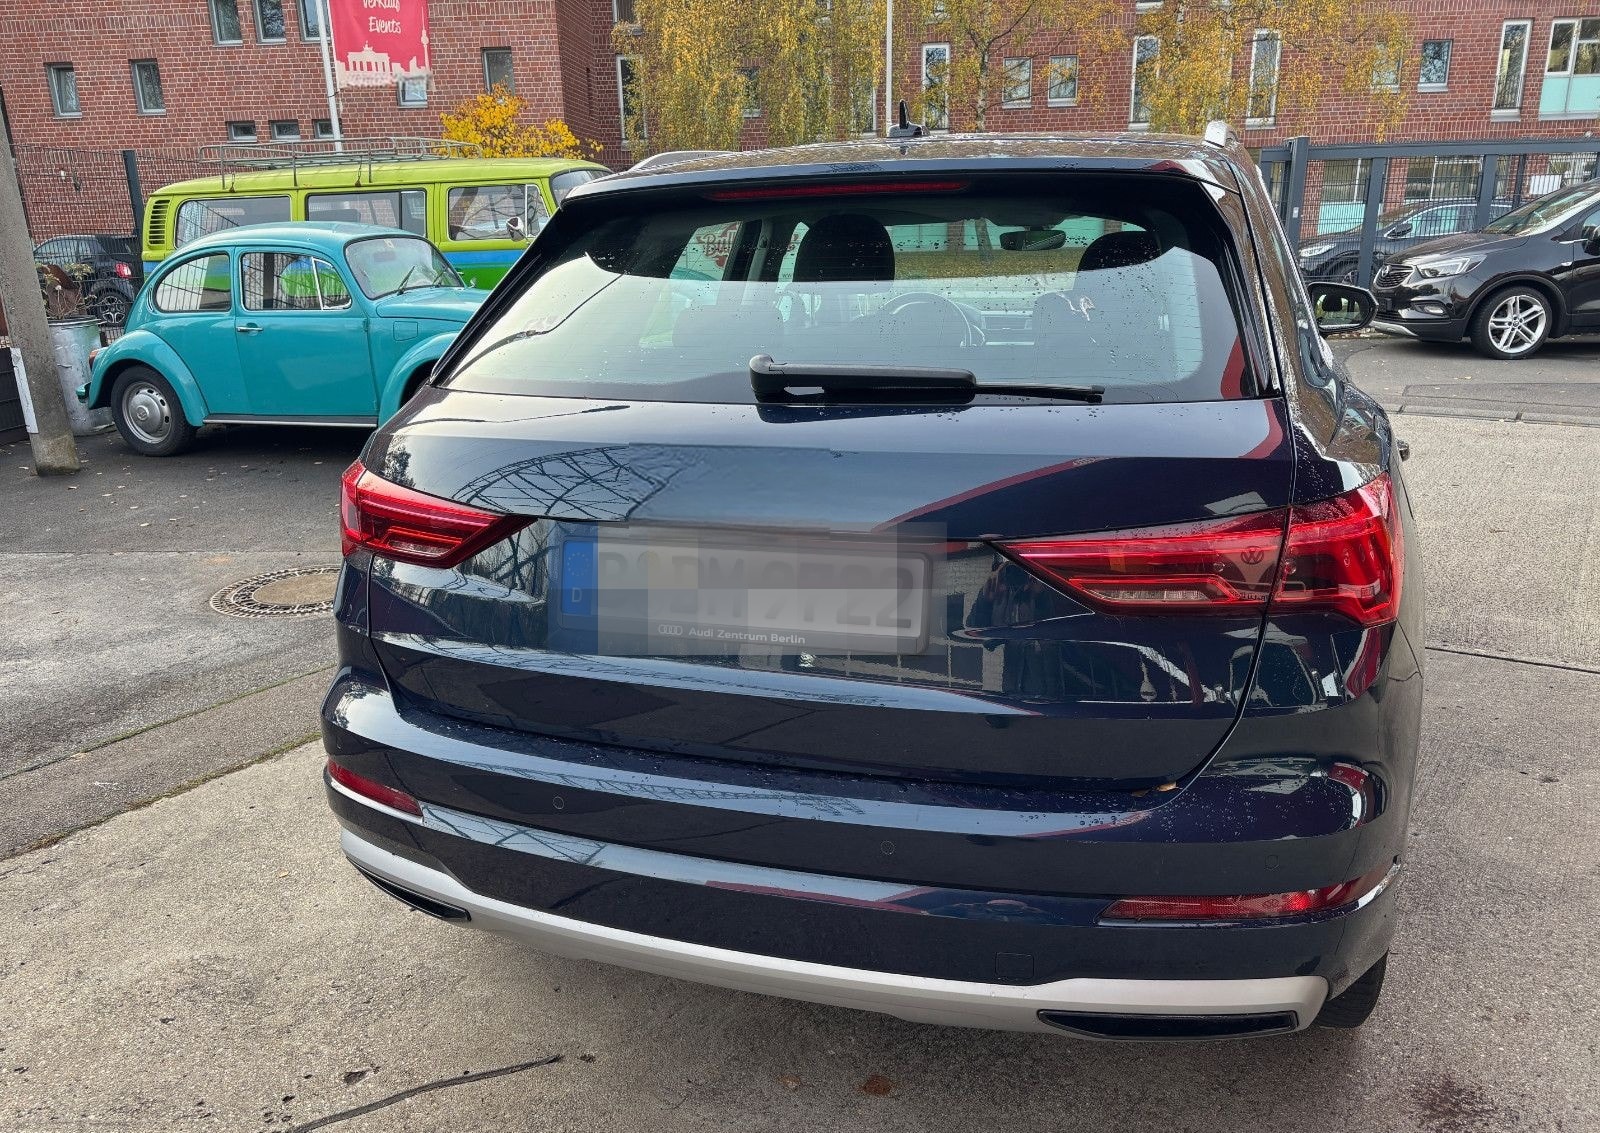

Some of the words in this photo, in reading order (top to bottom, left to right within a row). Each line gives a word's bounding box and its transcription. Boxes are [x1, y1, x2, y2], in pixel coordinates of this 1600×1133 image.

[368, 16, 401, 33] Events
[688, 627, 714, 638] Audi
[717, 629, 768, 642] Zentrum
[770, 633, 806, 644] Berlin
